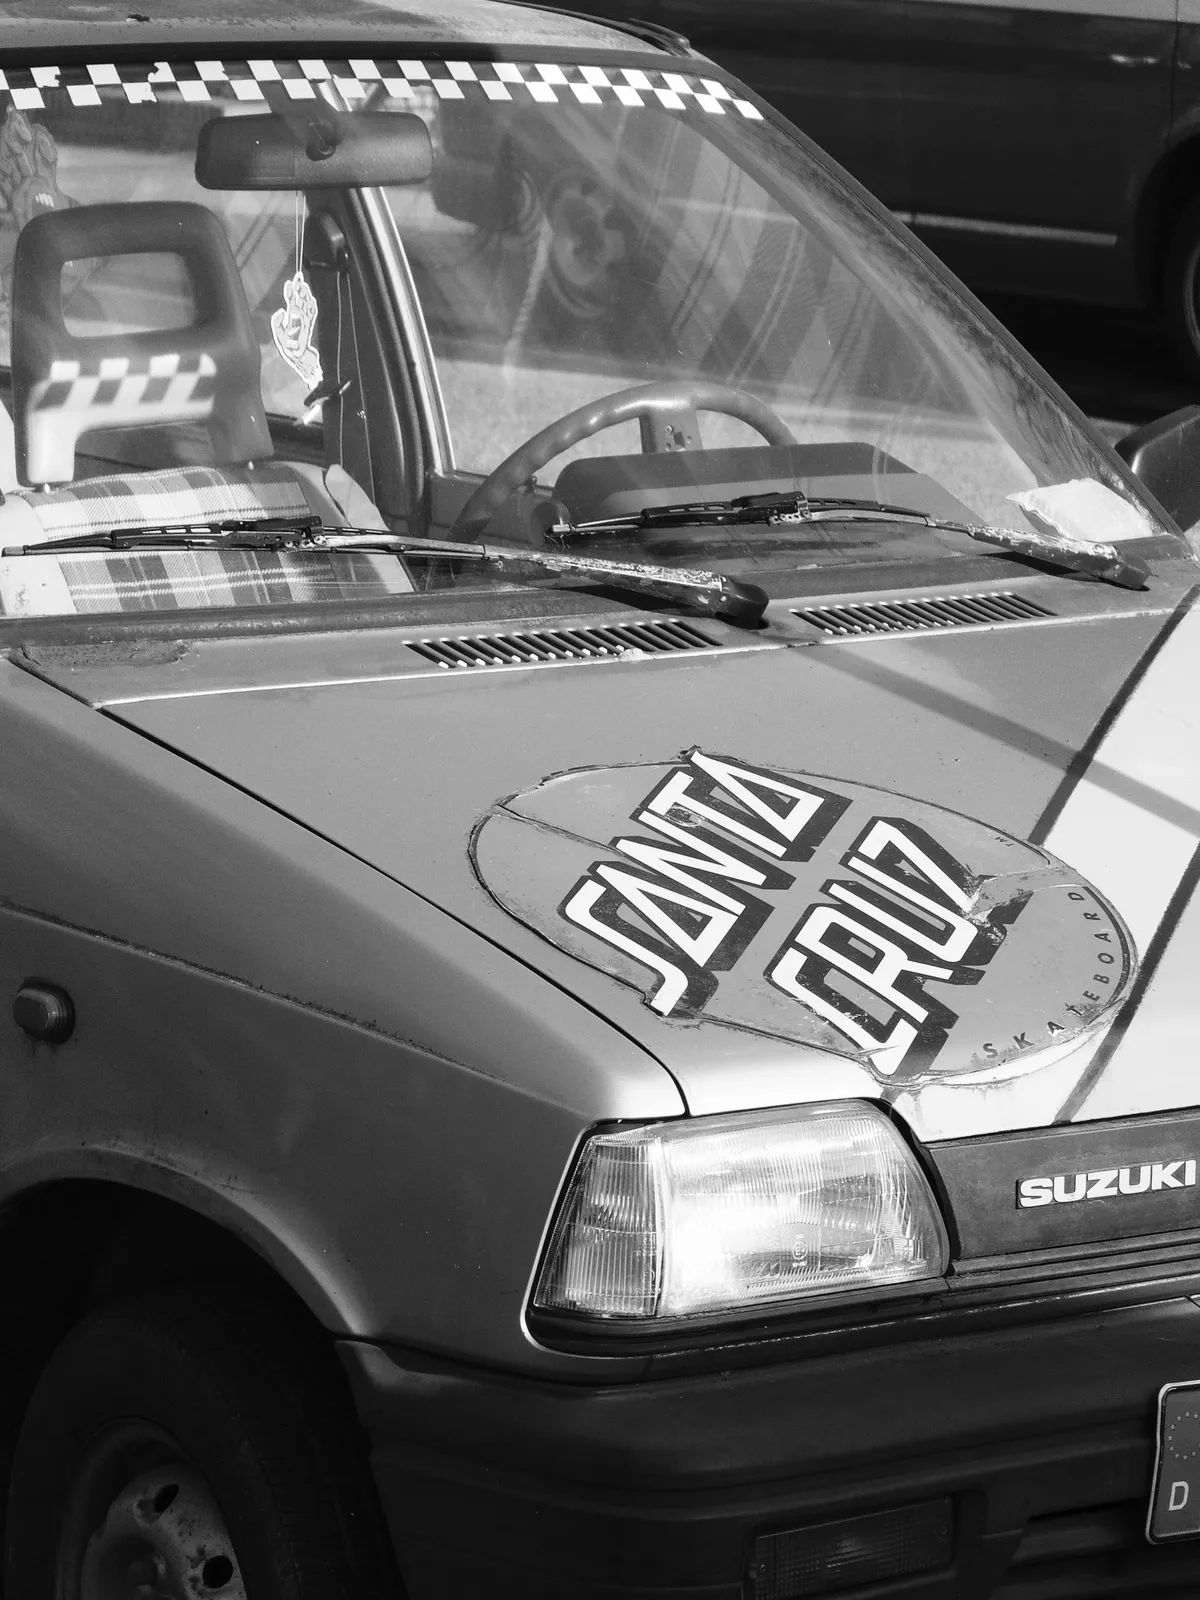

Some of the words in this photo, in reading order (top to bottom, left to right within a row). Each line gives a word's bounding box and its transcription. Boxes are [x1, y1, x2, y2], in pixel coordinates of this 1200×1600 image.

[562, 749, 828, 1018] SANTA
[772, 818, 982, 1077] CRUZ
[1019, 1159, 1197, 1208] SUZUKI
[1168, 1480, 1190, 1512] D
